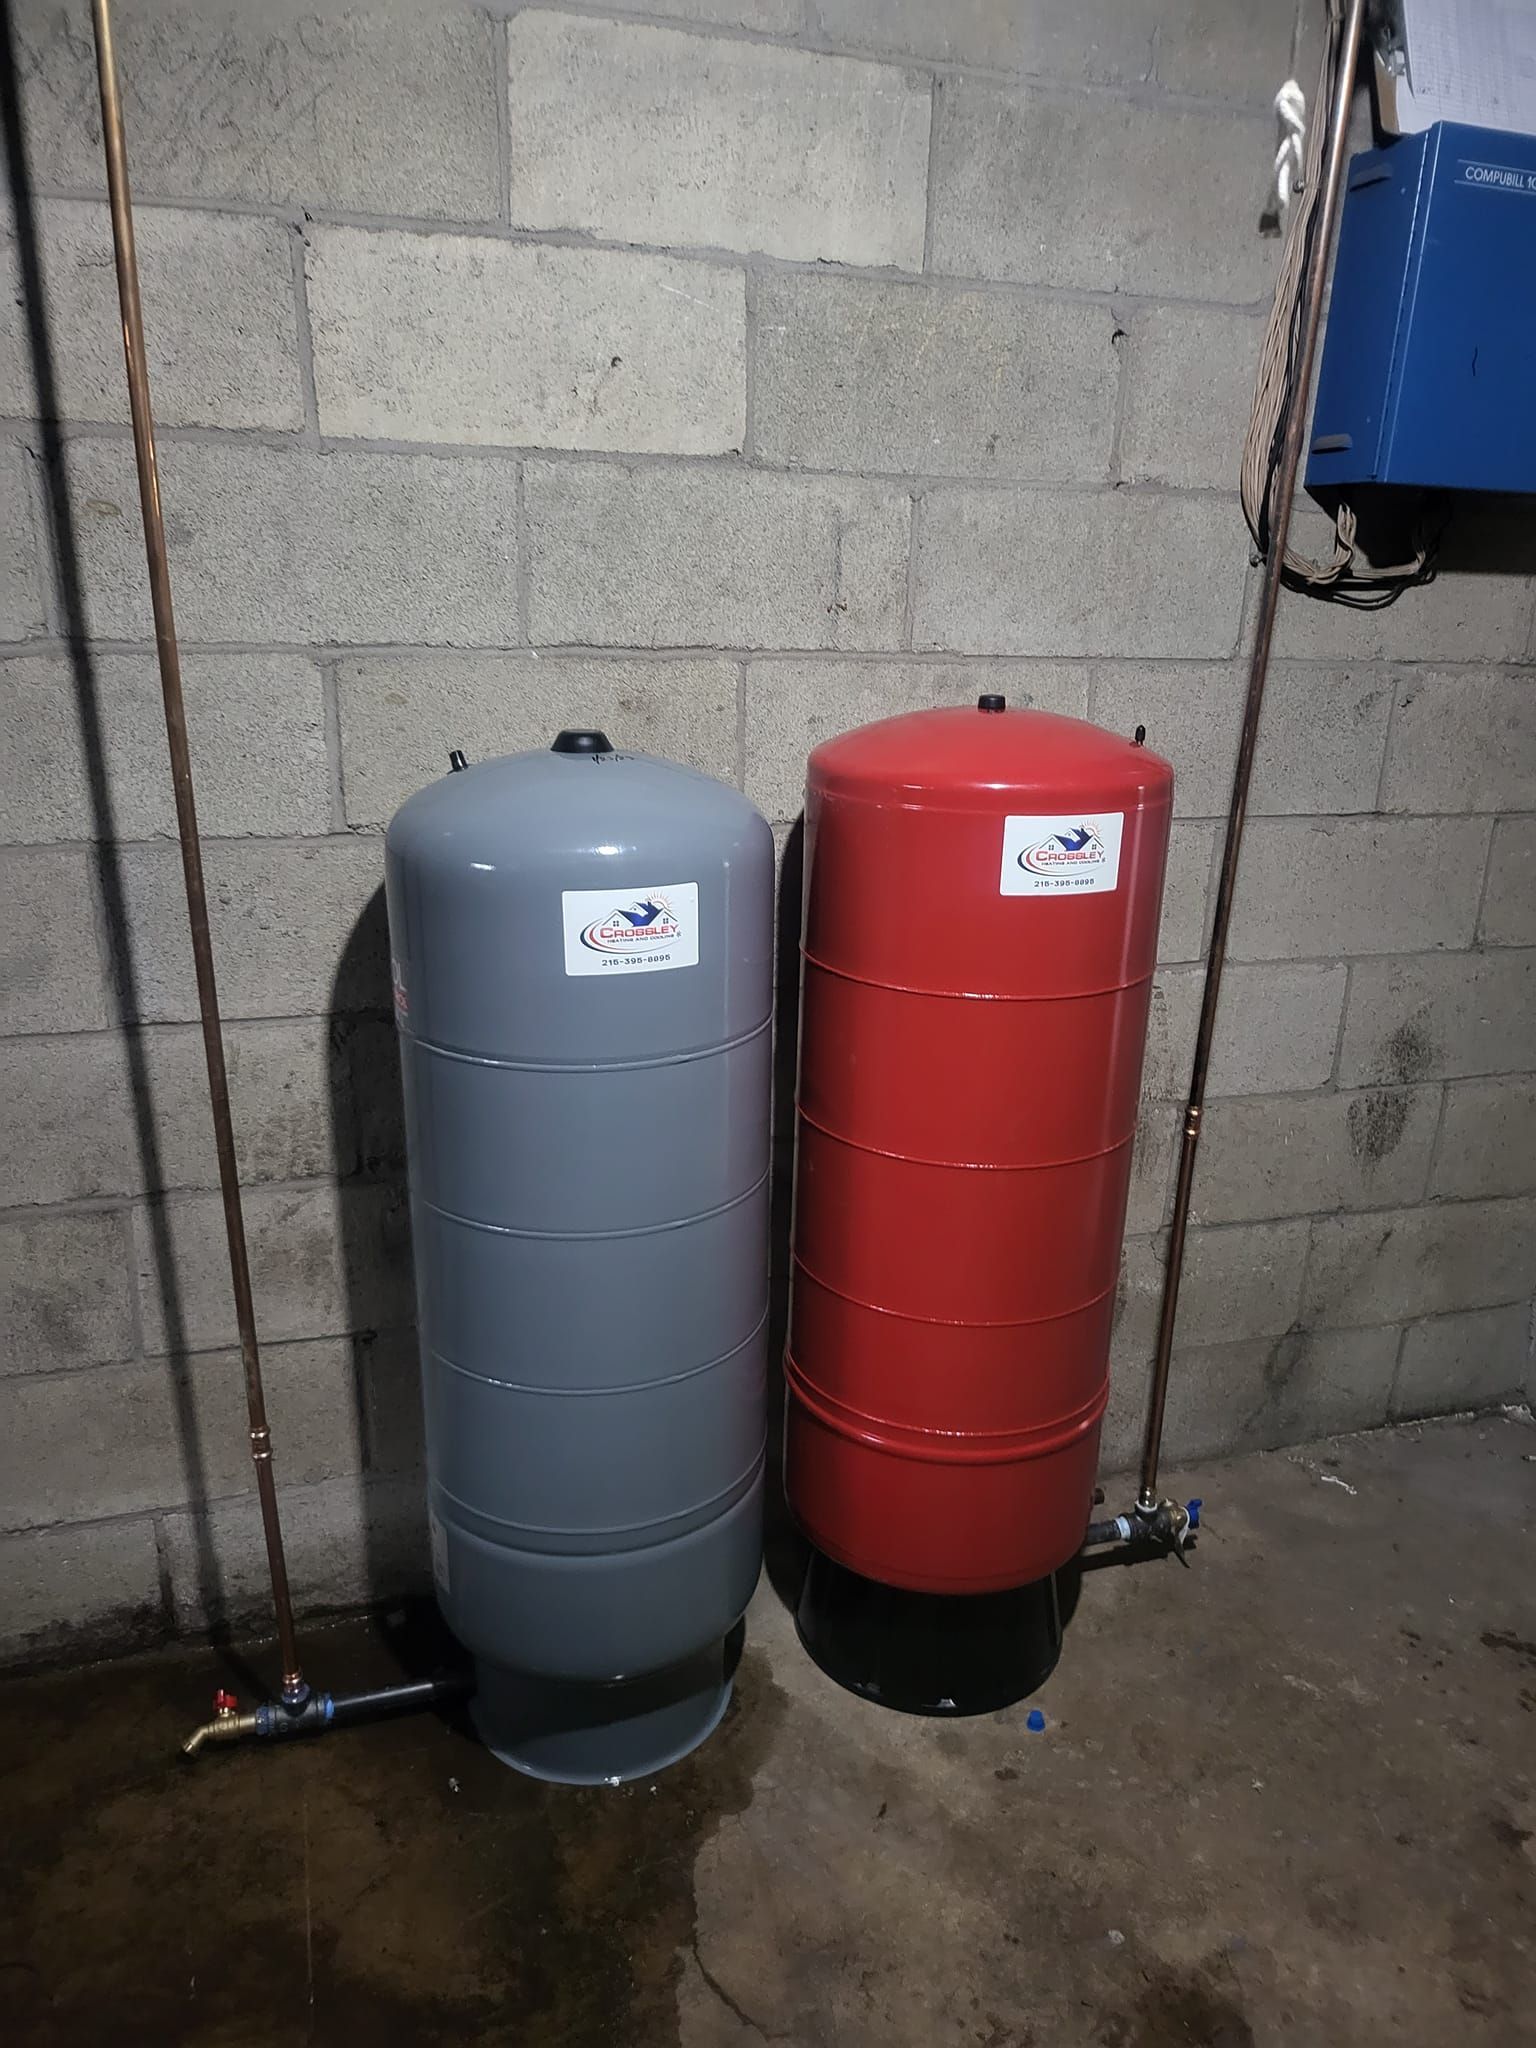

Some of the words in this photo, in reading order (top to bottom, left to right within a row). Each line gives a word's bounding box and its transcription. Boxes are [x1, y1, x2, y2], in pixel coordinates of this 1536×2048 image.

[1465, 166, 1524, 189] COMPUBILL
[1035, 850, 1104, 861] CROSSLEY
[600, 924, 679, 938] CROSSLEY
